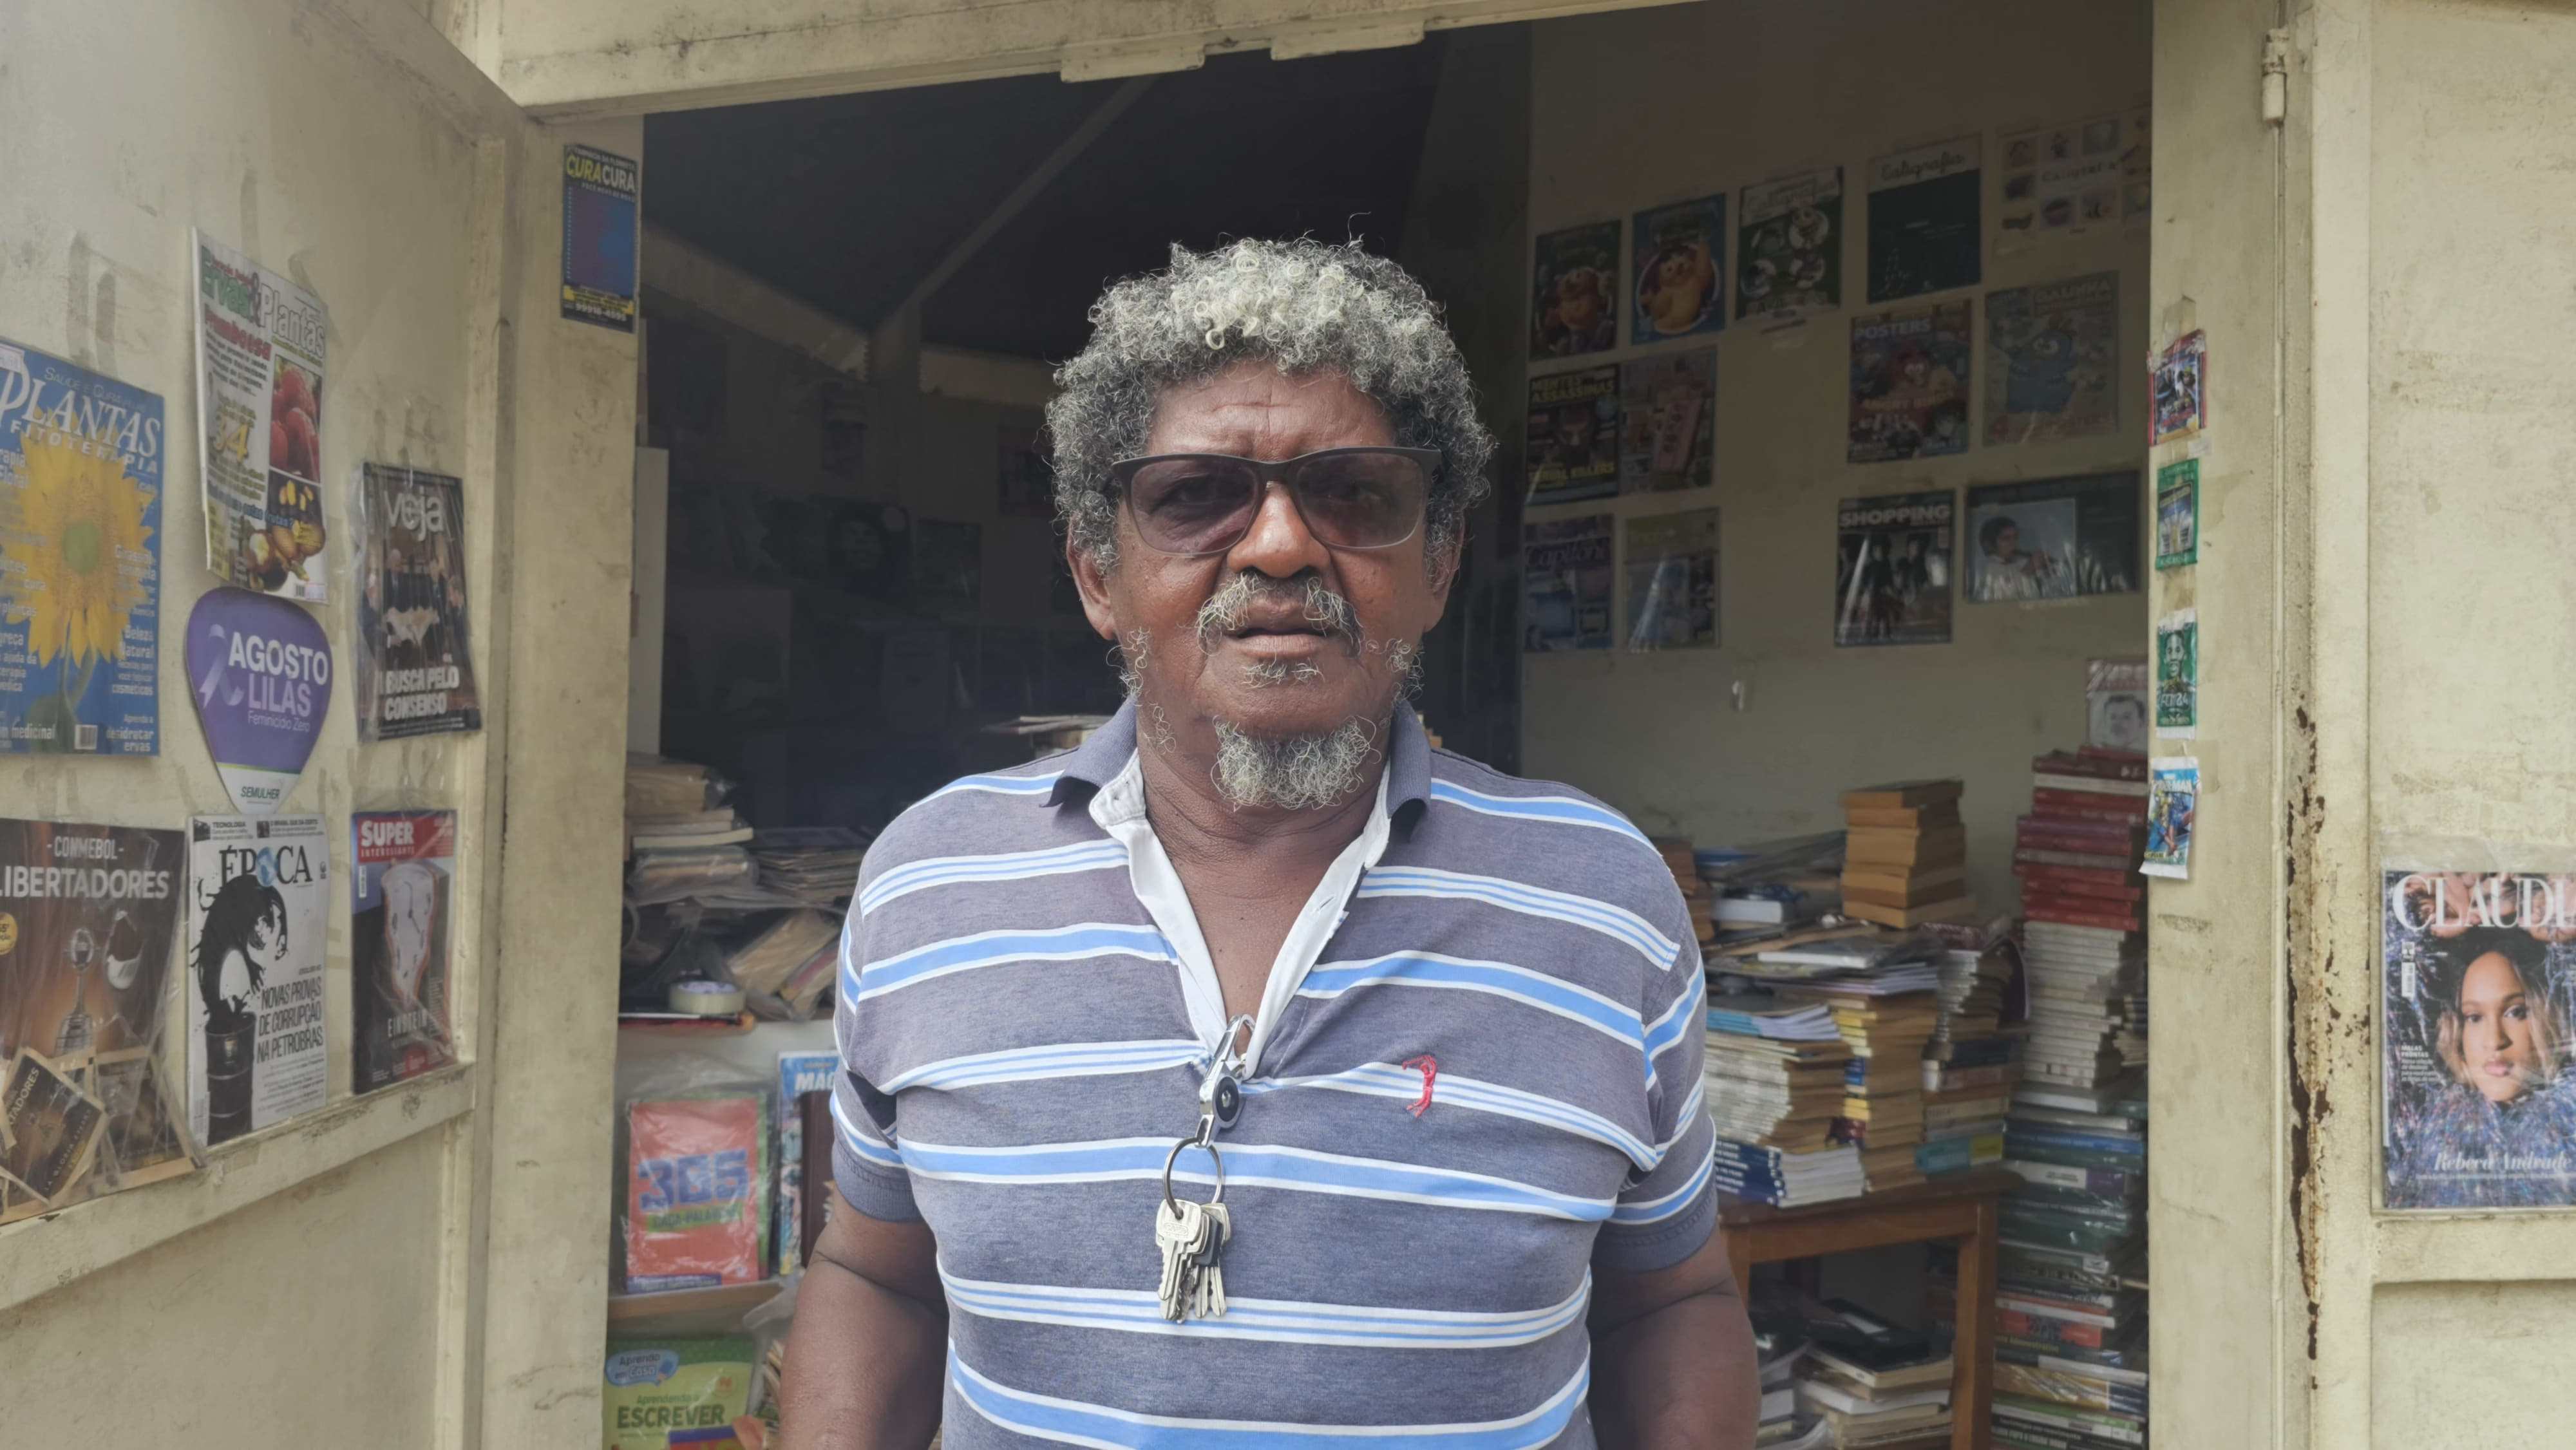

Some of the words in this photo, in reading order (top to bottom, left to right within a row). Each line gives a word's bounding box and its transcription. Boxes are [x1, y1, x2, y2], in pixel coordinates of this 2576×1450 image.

[259, 282, 325, 359] Plantas
[1854, 318, 1932, 340] POSTERS
[0, 348, 161, 458] PLANTAS
[10, 420, 158, 475] FITOTERAPIA
[384, 484, 444, 541] veja
[1839, 504, 1951, 528] SHOPPING
[228, 631, 328, 686] AGOSTO
[248, 673, 312, 717] LILAS
[384, 691, 448, 721] CONSENSO
[292, 717, 310, 731] Zero
[240, 786, 280, 800] SEMULHER
[361, 820, 415, 848] SUPER
[0, 865, 171, 899] IBERTADORES
[219, 845, 313, 889] ÉPOCA
[2392, 874, 2576, 930] CLAUDI
[261, 983, 290, 1011] NOVAS
[290, 975, 321, 1003] PROVAS
[258, 1012, 272, 1037] DE
[272, 999, 321, 1033] CORRUPÇÃO
[256, 1040, 270, 1064] NA
[270, 1025, 324, 1060] PETROBRAS
[637, 1149, 751, 1212] 365
[616, 1404, 725, 1429] ESCREVER
